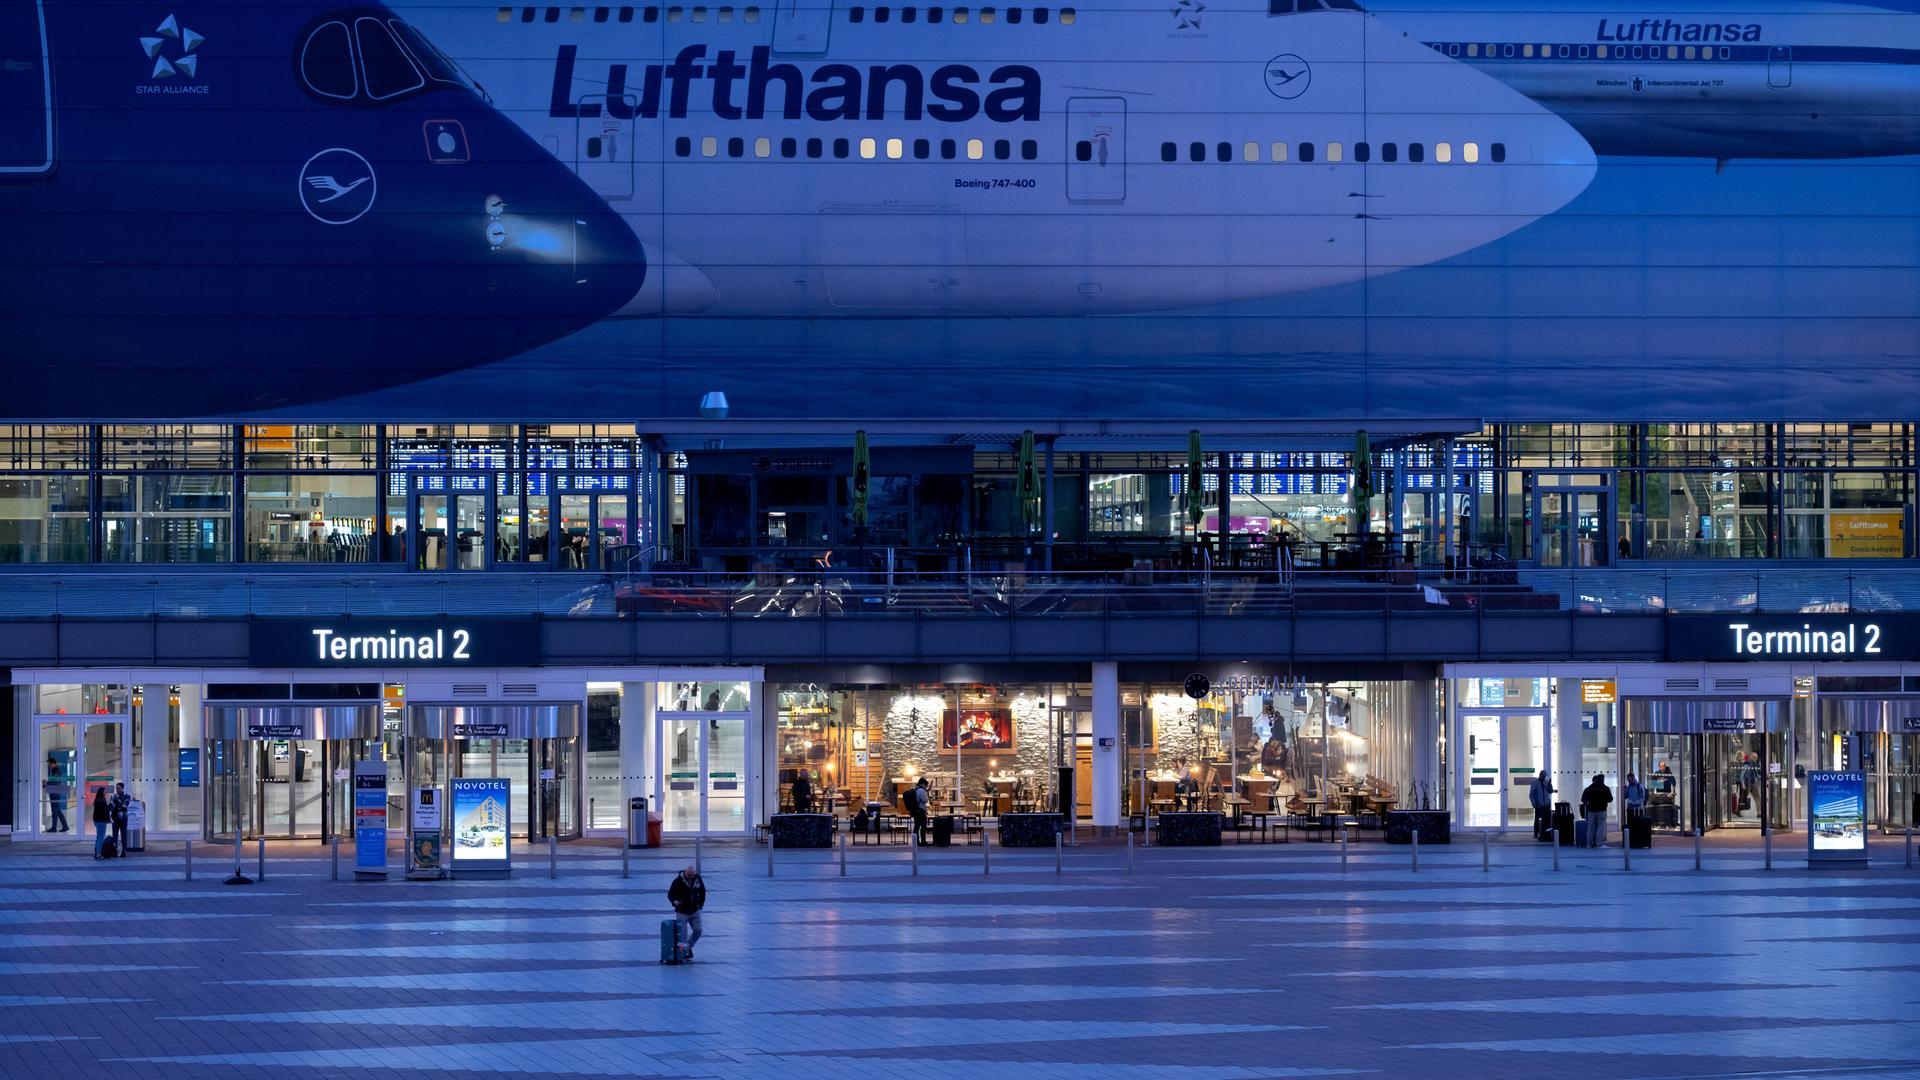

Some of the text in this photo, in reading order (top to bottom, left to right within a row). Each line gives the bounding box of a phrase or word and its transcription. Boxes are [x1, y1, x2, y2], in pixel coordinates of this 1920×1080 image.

[1597, 19, 1762, 42] Lufthansa
[548, 44, 1041, 122] Lufthansa
[1647, 79, 1724, 87] Intercontinental Jet 707
[135, 85, 209, 94] STAR ALLIANCE
[955, 178, 1036, 190] Boeing 747-400
[1850, 521, 1888, 529] Lufthansa
[312, 629, 470, 659] Terminal 2
[1729, 623, 1881, 653] Terminal 2
[455, 782, 506, 790] NOVOTEL
